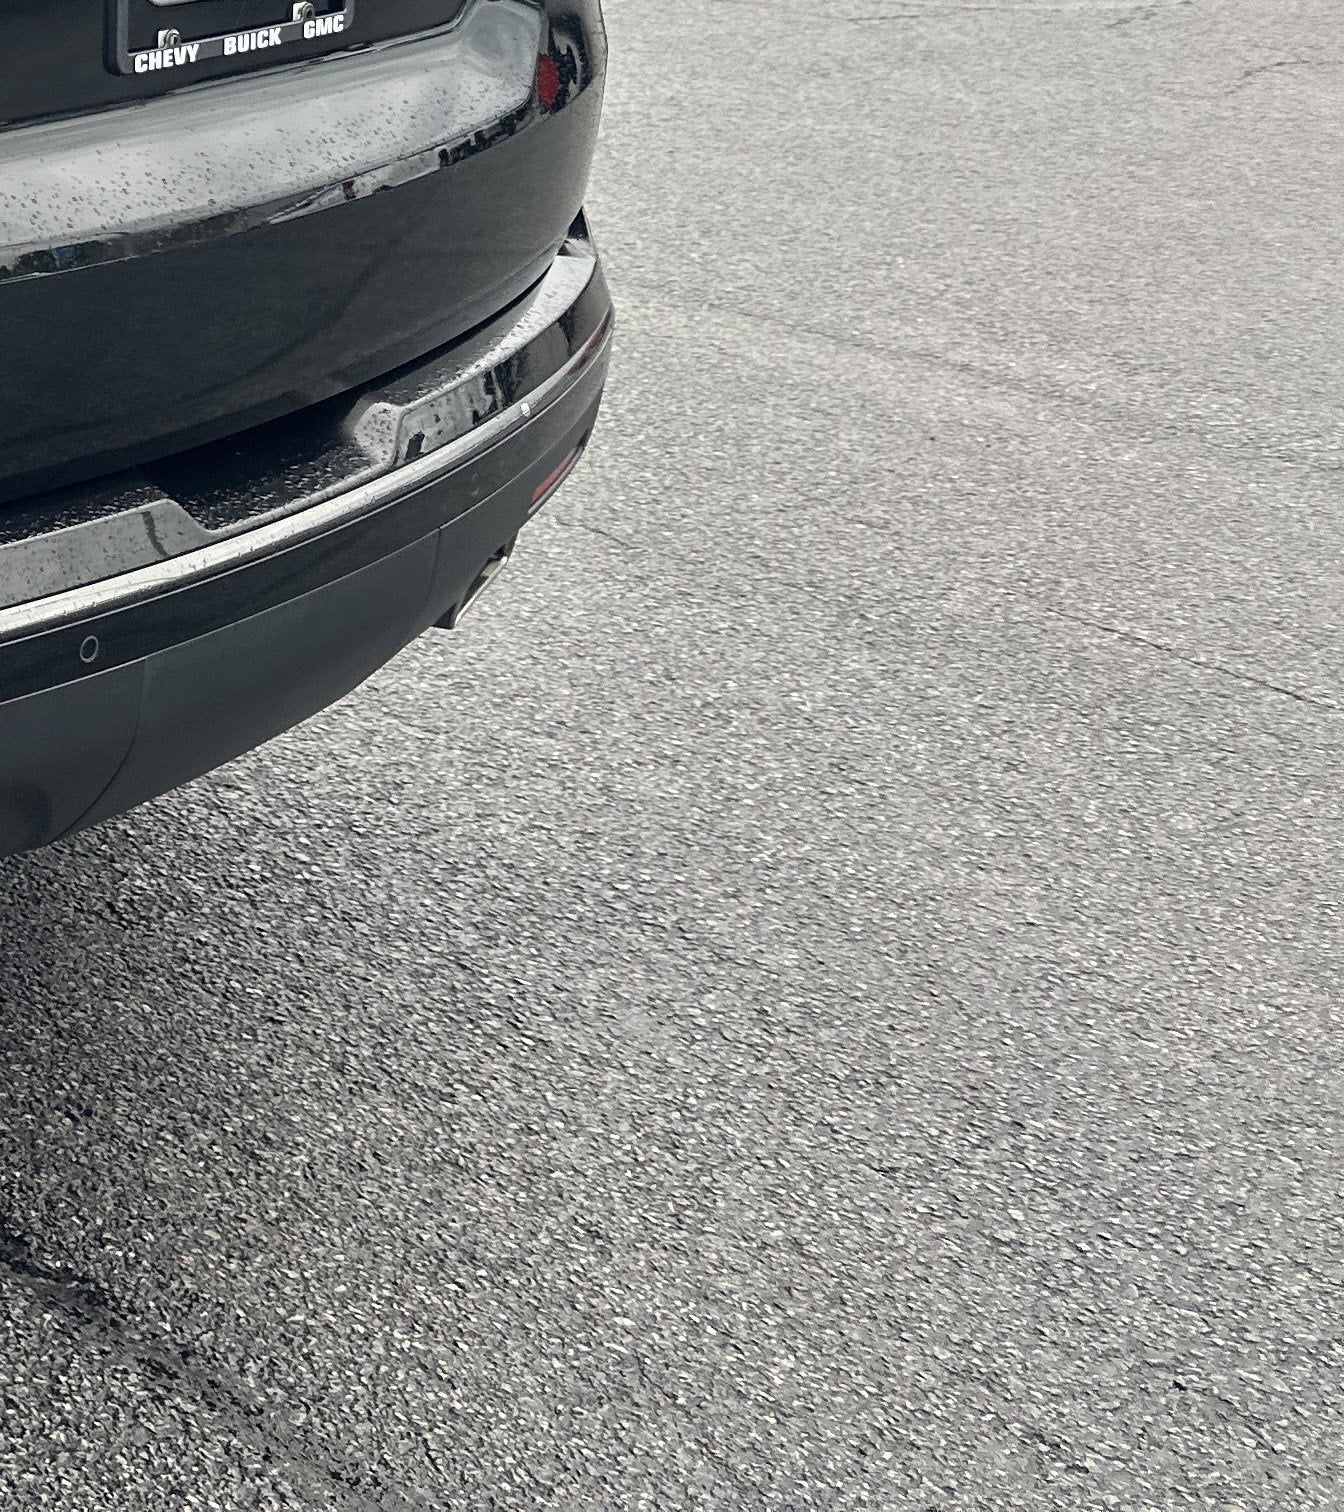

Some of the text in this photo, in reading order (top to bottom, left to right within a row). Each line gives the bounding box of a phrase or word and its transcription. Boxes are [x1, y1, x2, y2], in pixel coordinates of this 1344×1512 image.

[134, 14, 344, 73] CHEVY BUICK GMC
